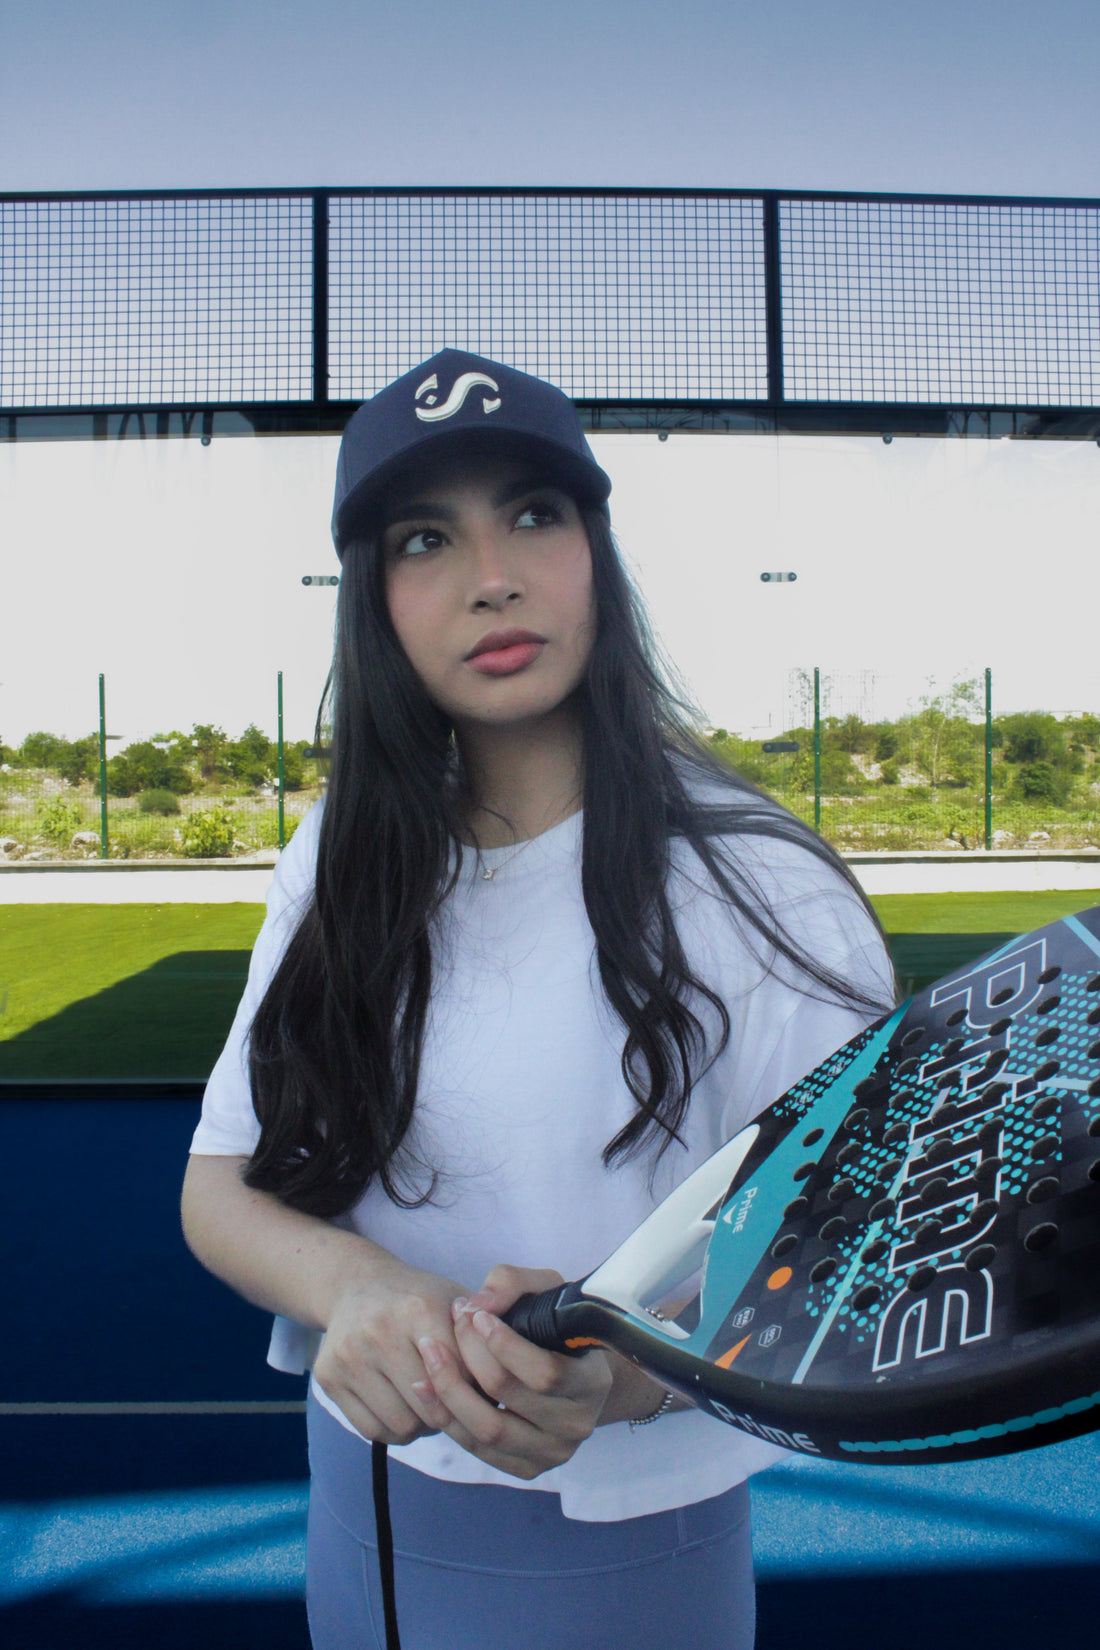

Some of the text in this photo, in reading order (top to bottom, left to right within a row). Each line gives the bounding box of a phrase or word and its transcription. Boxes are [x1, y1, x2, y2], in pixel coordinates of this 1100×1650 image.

[872, 938, 1047, 1372] Prime
[732, 1186, 758, 1234] Prime
[709, 1398, 821, 1453] Prime
